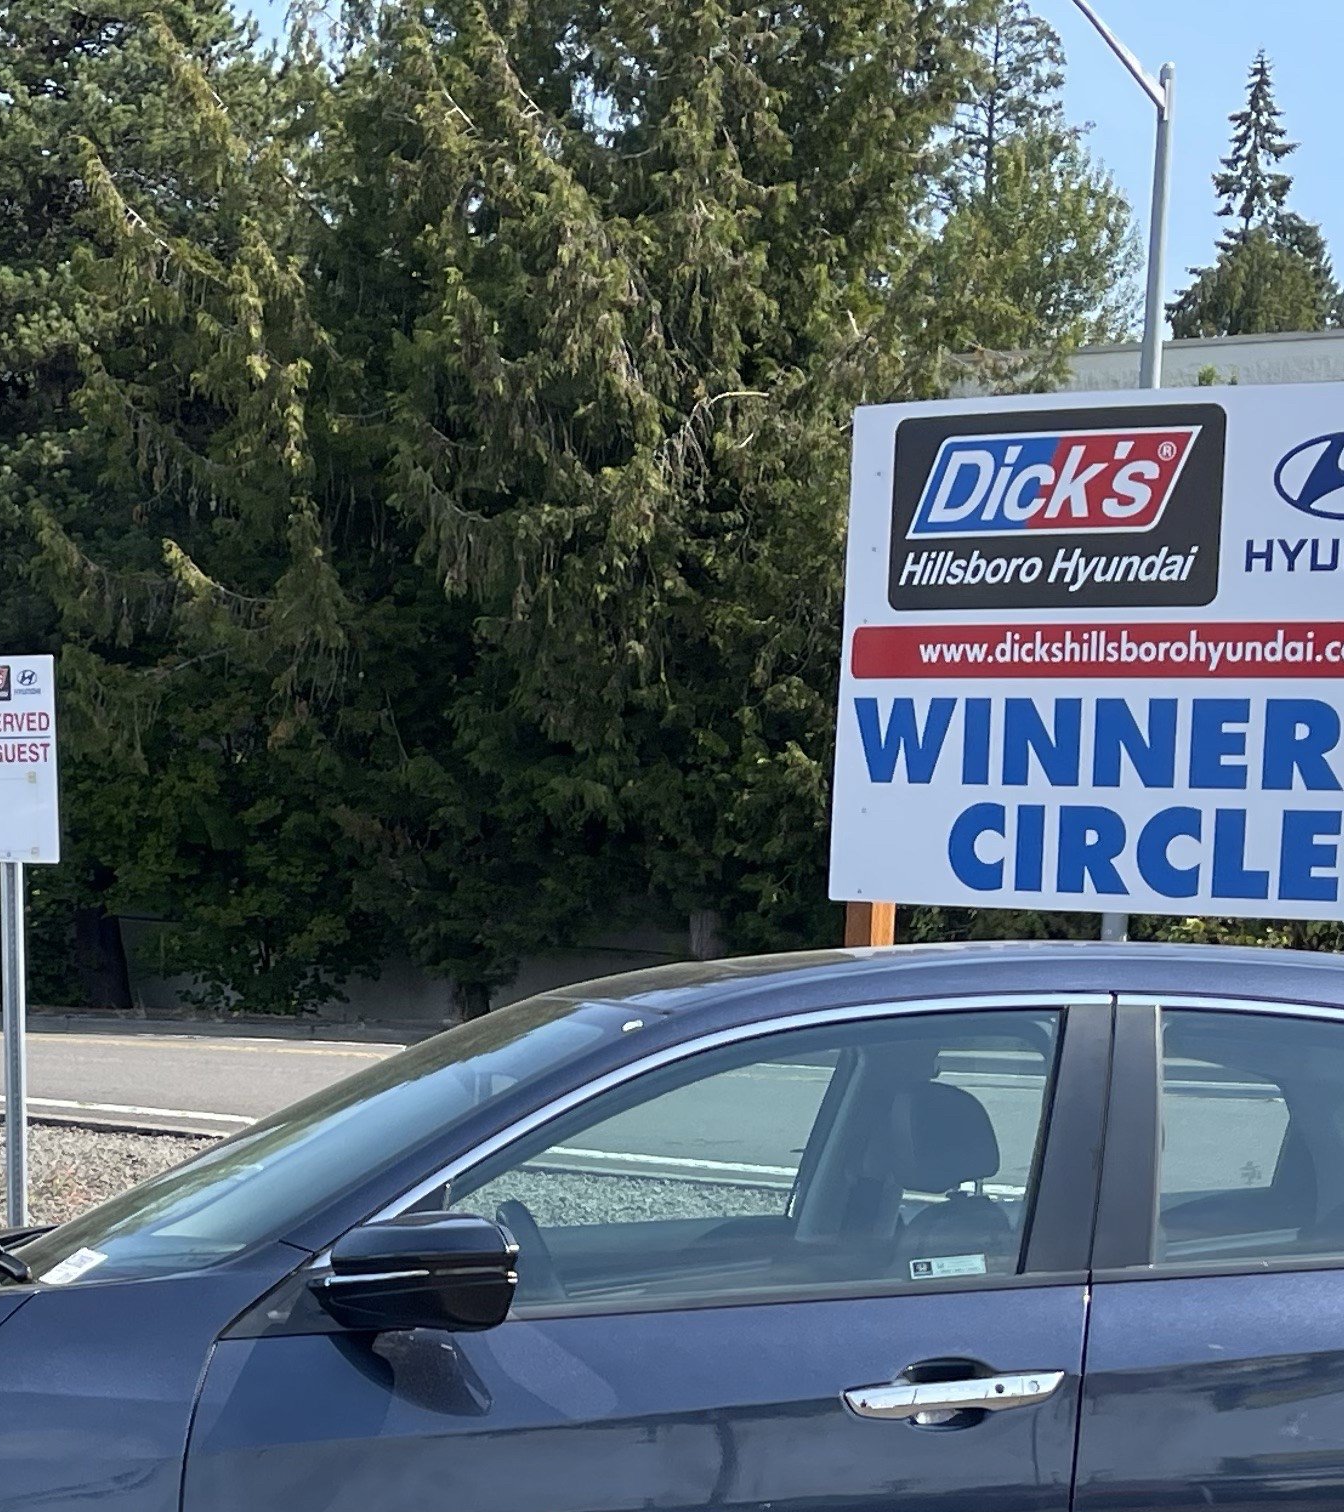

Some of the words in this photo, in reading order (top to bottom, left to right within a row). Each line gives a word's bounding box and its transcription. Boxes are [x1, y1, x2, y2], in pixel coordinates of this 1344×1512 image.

[927, 441, 1160, 523] Dick's
[899, 550, 1042, 586] Hillsboro
[1047, 546, 1199, 592] Hyundai
[948, 803, 1342, 900] CIRCLE
